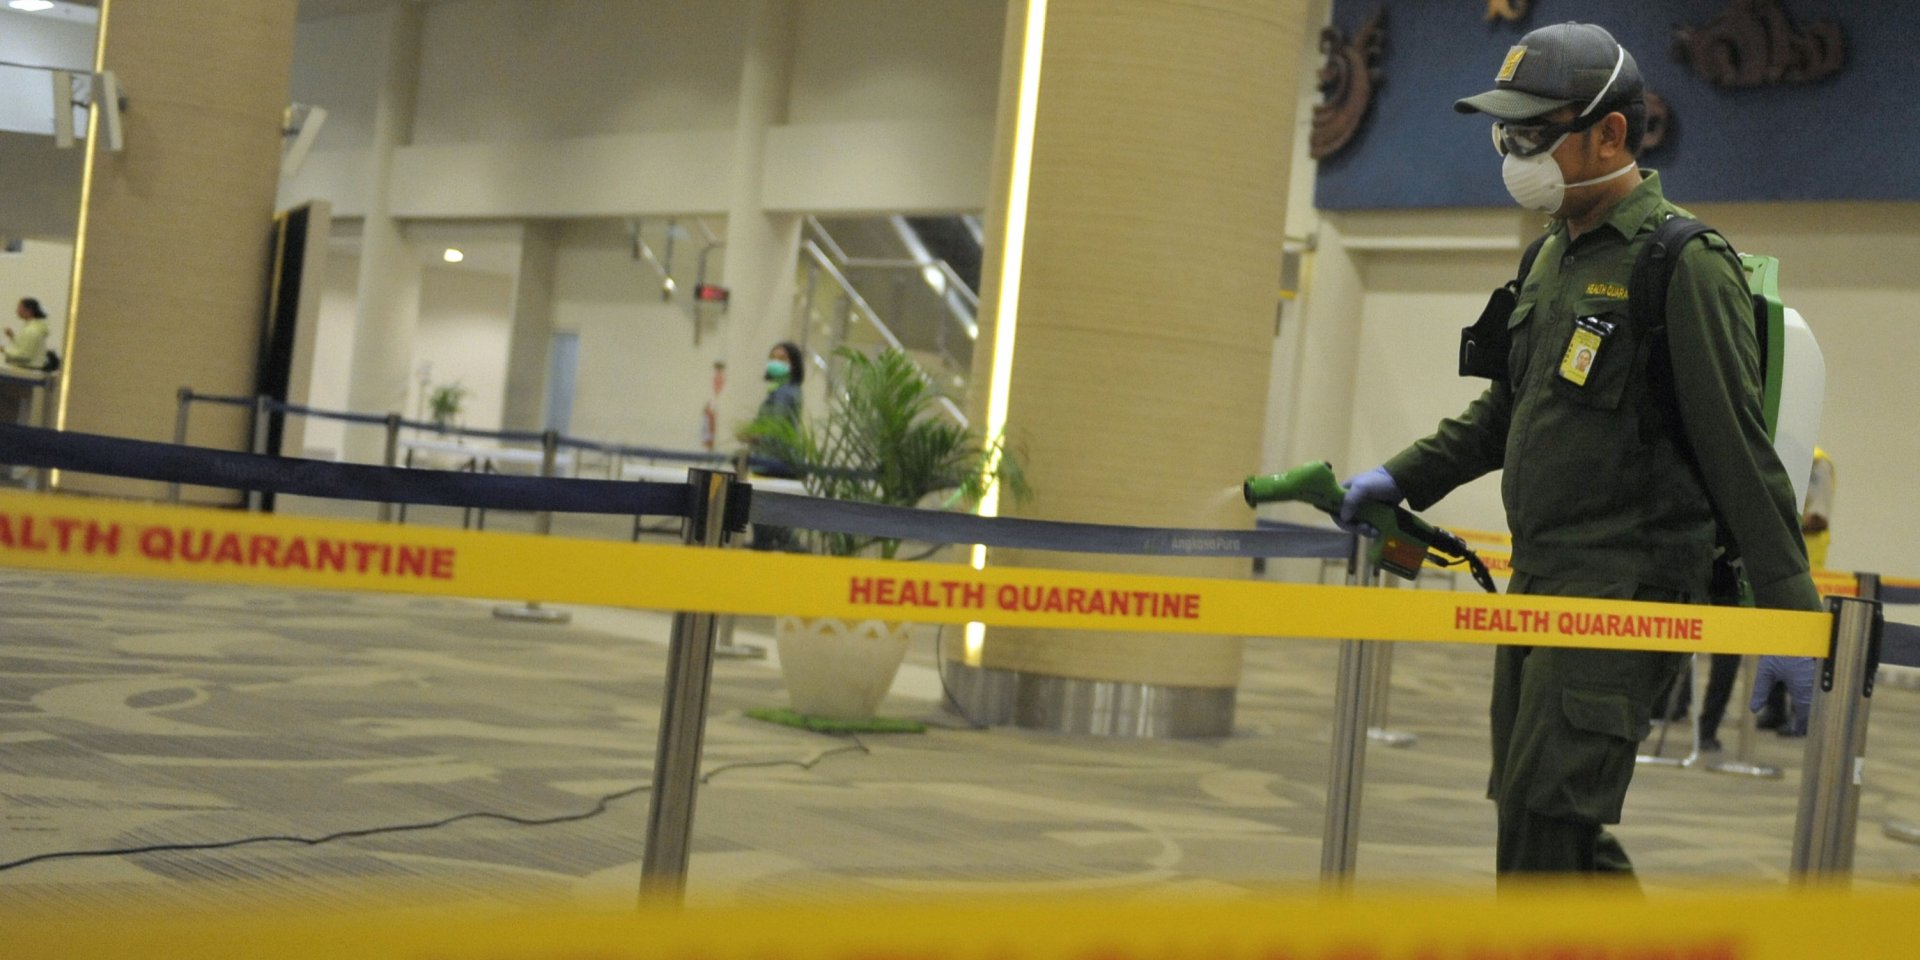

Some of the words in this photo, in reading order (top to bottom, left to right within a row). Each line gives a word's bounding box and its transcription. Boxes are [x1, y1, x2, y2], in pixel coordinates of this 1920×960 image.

[137, 525, 456, 580] QUARANTINE
[849, 577, 986, 609] HEALTH
[996, 583, 1201, 620] QUARANTINE
[1454, 606, 1550, 633] HEALTH
[1557, 611, 1703, 641] QUARANTINE
